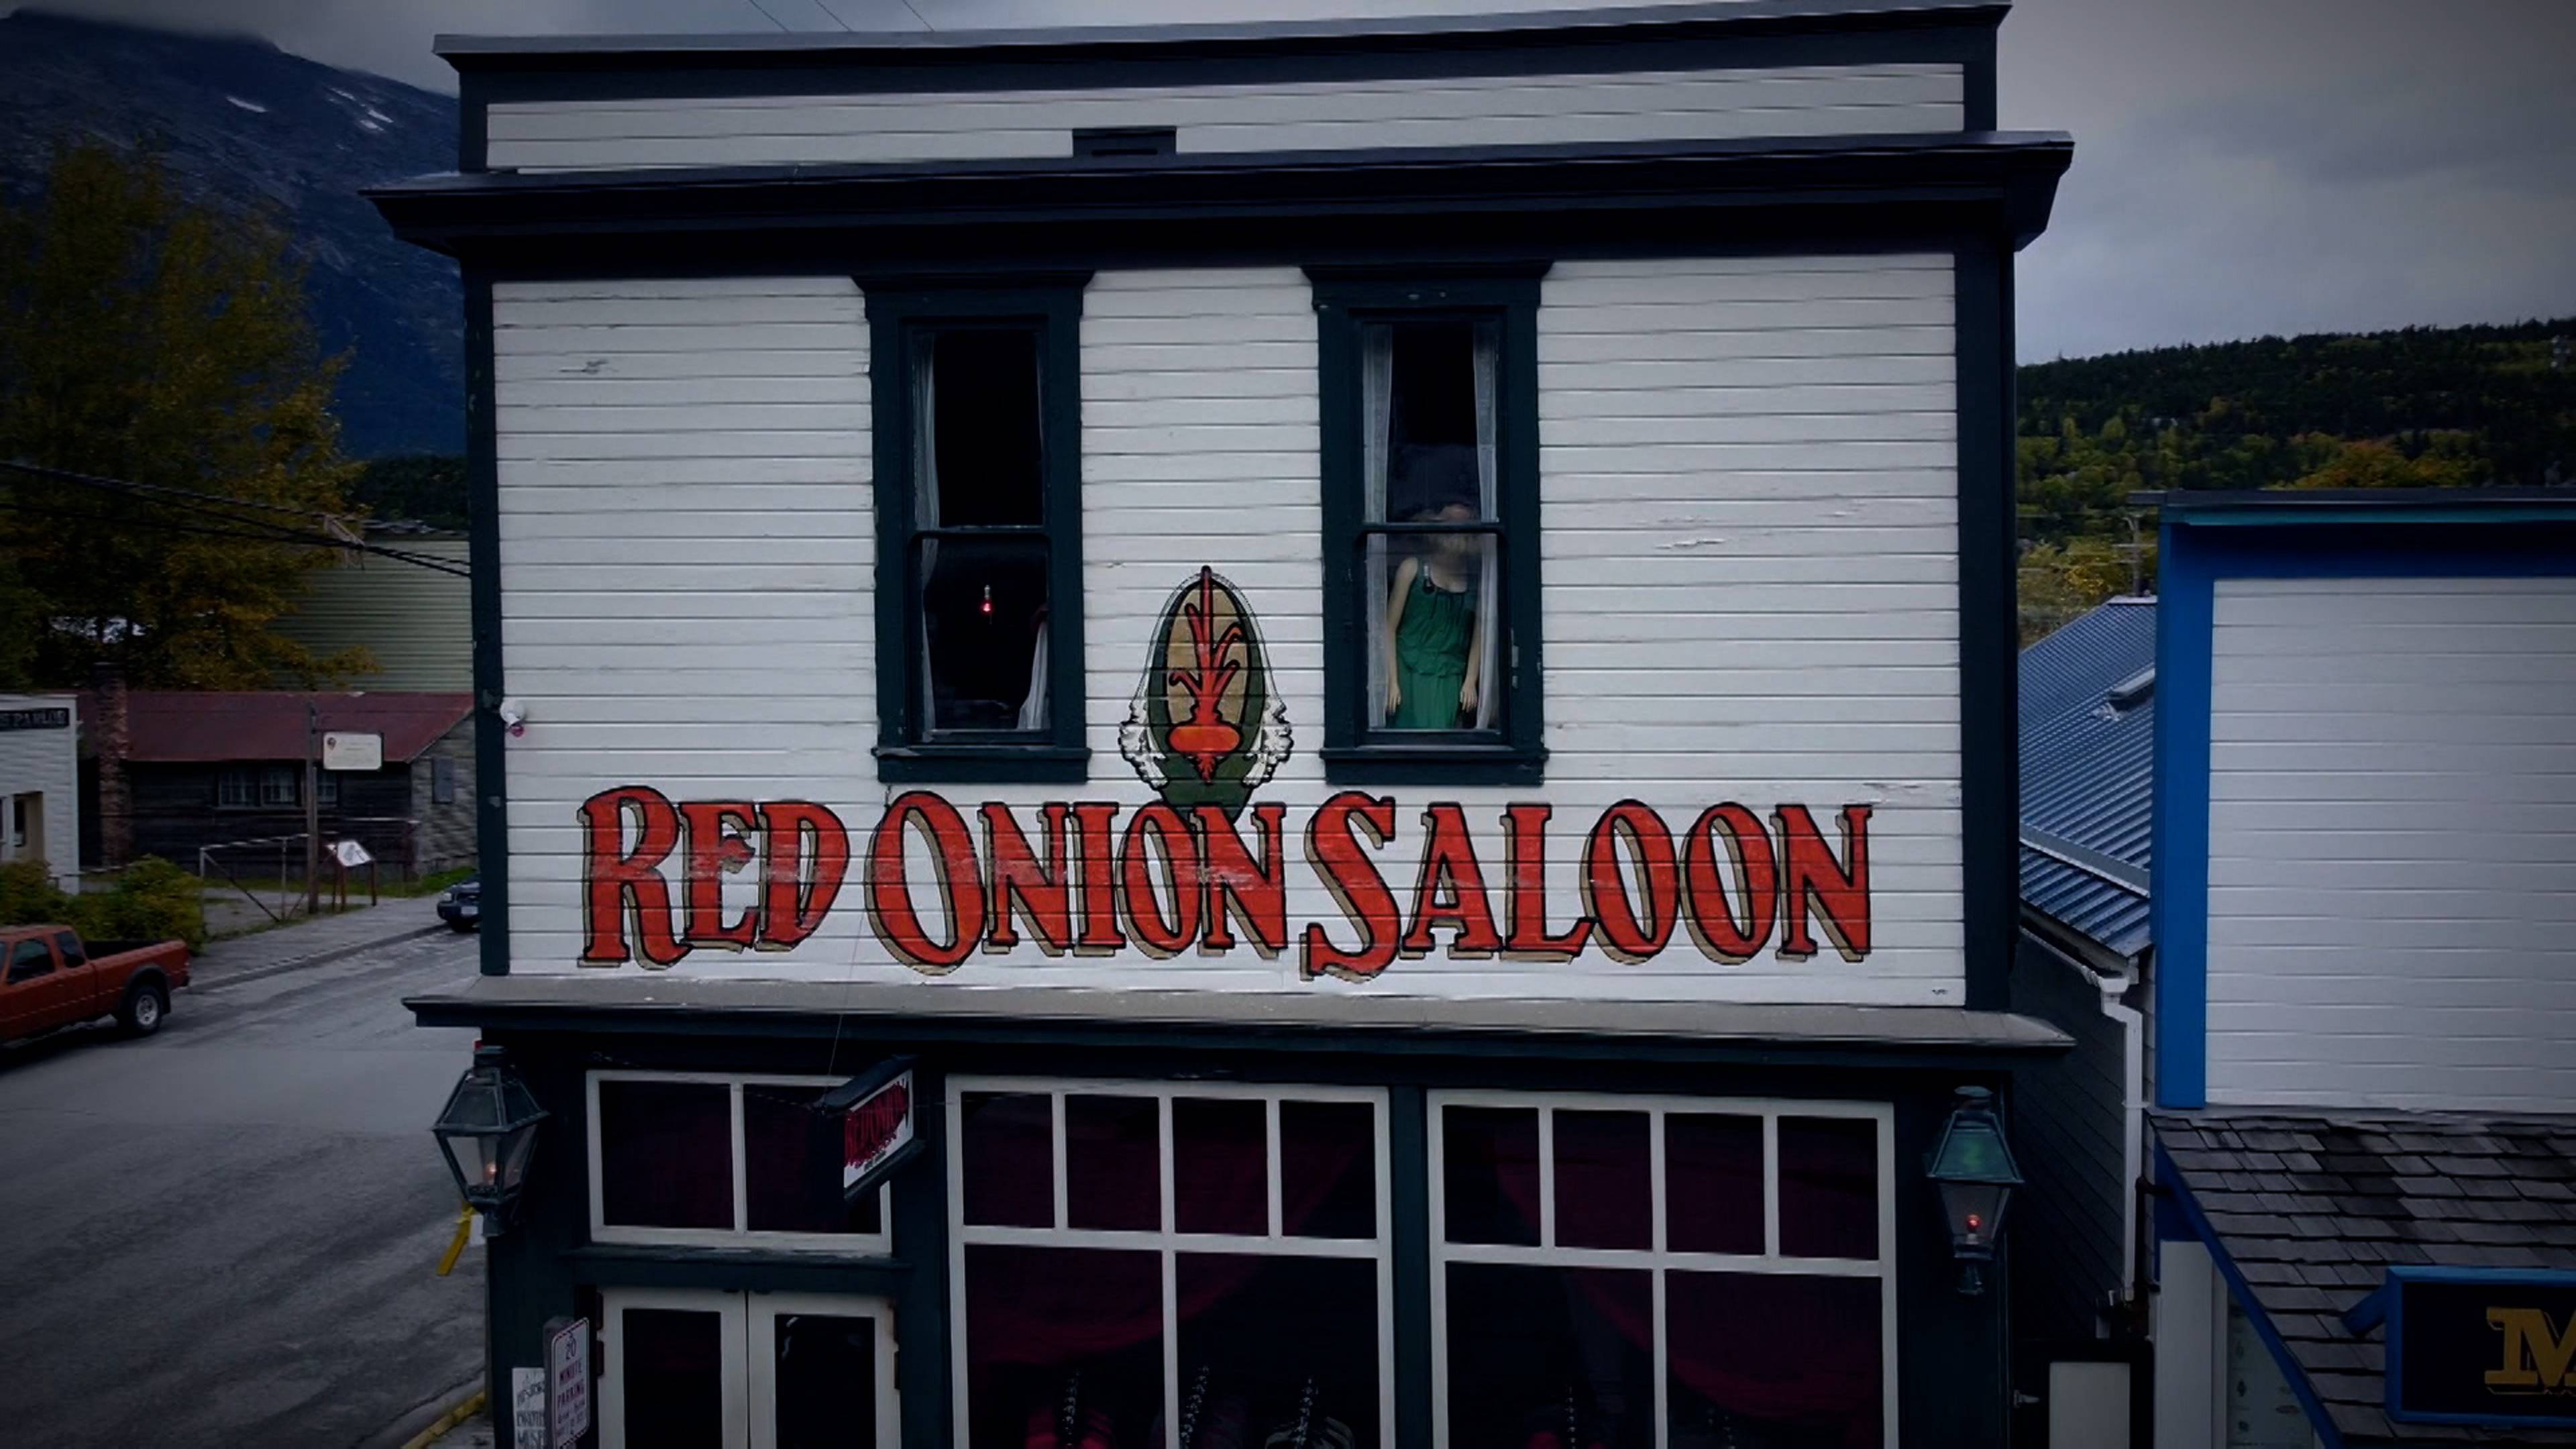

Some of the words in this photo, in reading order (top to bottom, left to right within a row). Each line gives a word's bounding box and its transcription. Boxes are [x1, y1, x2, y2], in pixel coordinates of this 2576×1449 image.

[577, 786, 849, 970] RED
[865, 790, 1287, 975] ONION
[1299, 791, 1872, 983] SALOON
[566, 1334, 577, 1360] 20
